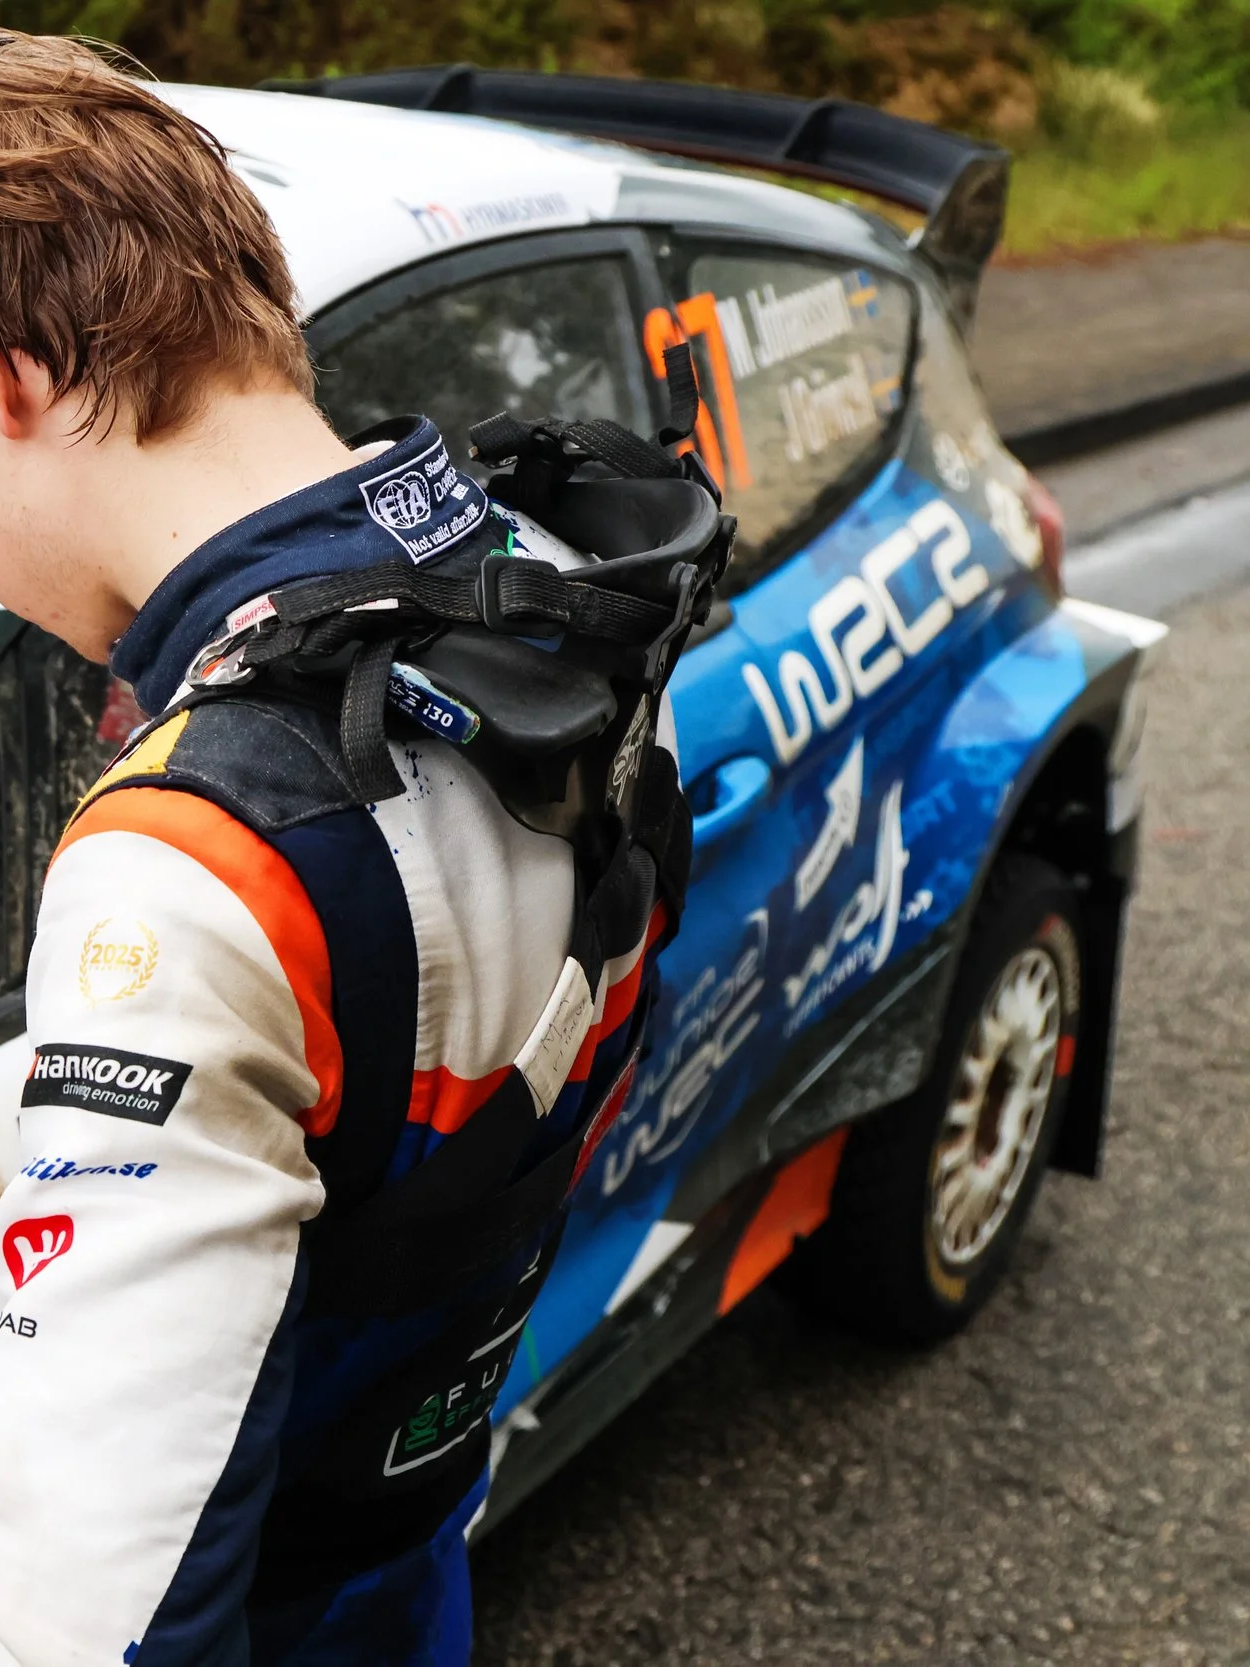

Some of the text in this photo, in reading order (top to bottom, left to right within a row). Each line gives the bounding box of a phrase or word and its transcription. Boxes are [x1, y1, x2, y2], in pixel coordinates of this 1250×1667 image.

[376, 482, 430, 526] FIA
[408, 534, 432, 555] Not
[430, 523, 452, 546] valid
[742, 499, 990, 766] WRC2
[90, 943, 145, 967] 2025
[62, 1081, 160, 1113] driving emotion
